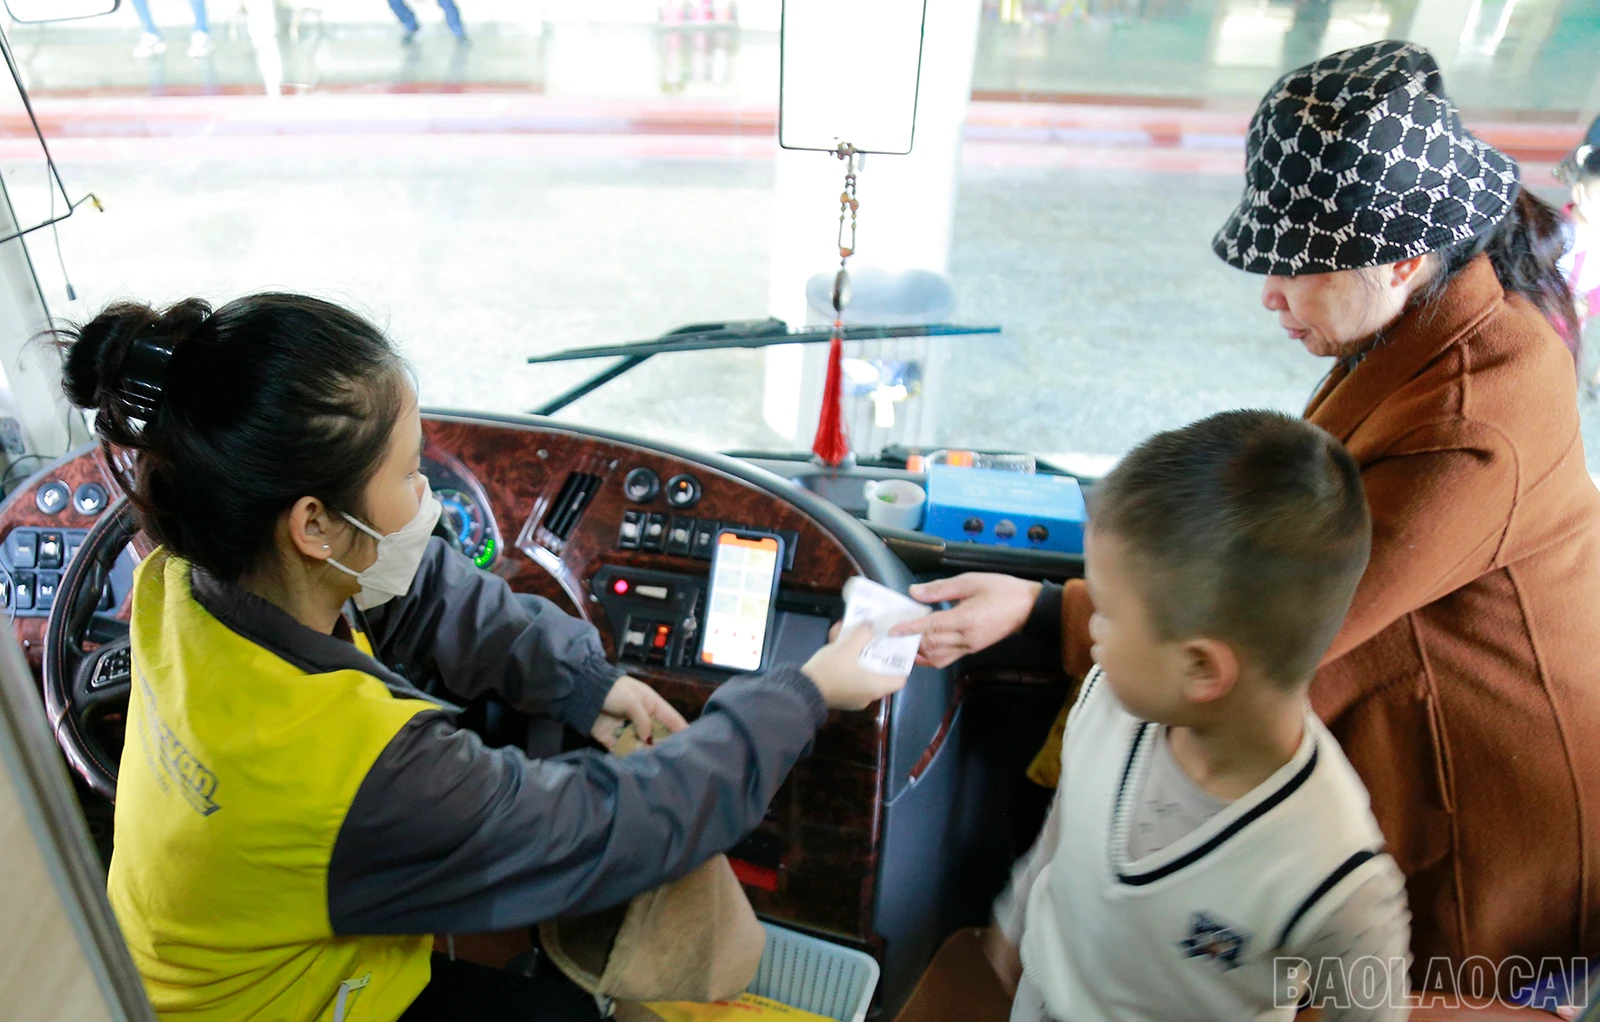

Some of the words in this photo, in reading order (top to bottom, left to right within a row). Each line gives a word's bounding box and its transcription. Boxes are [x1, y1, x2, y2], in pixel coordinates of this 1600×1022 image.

[1365, 99, 1389, 125] NY
[1426, 184, 1451, 203] NY
[1379, 201, 1404, 221] NY
[1332, 223, 1356, 245] NY
[1288, 248, 1310, 271] NY
